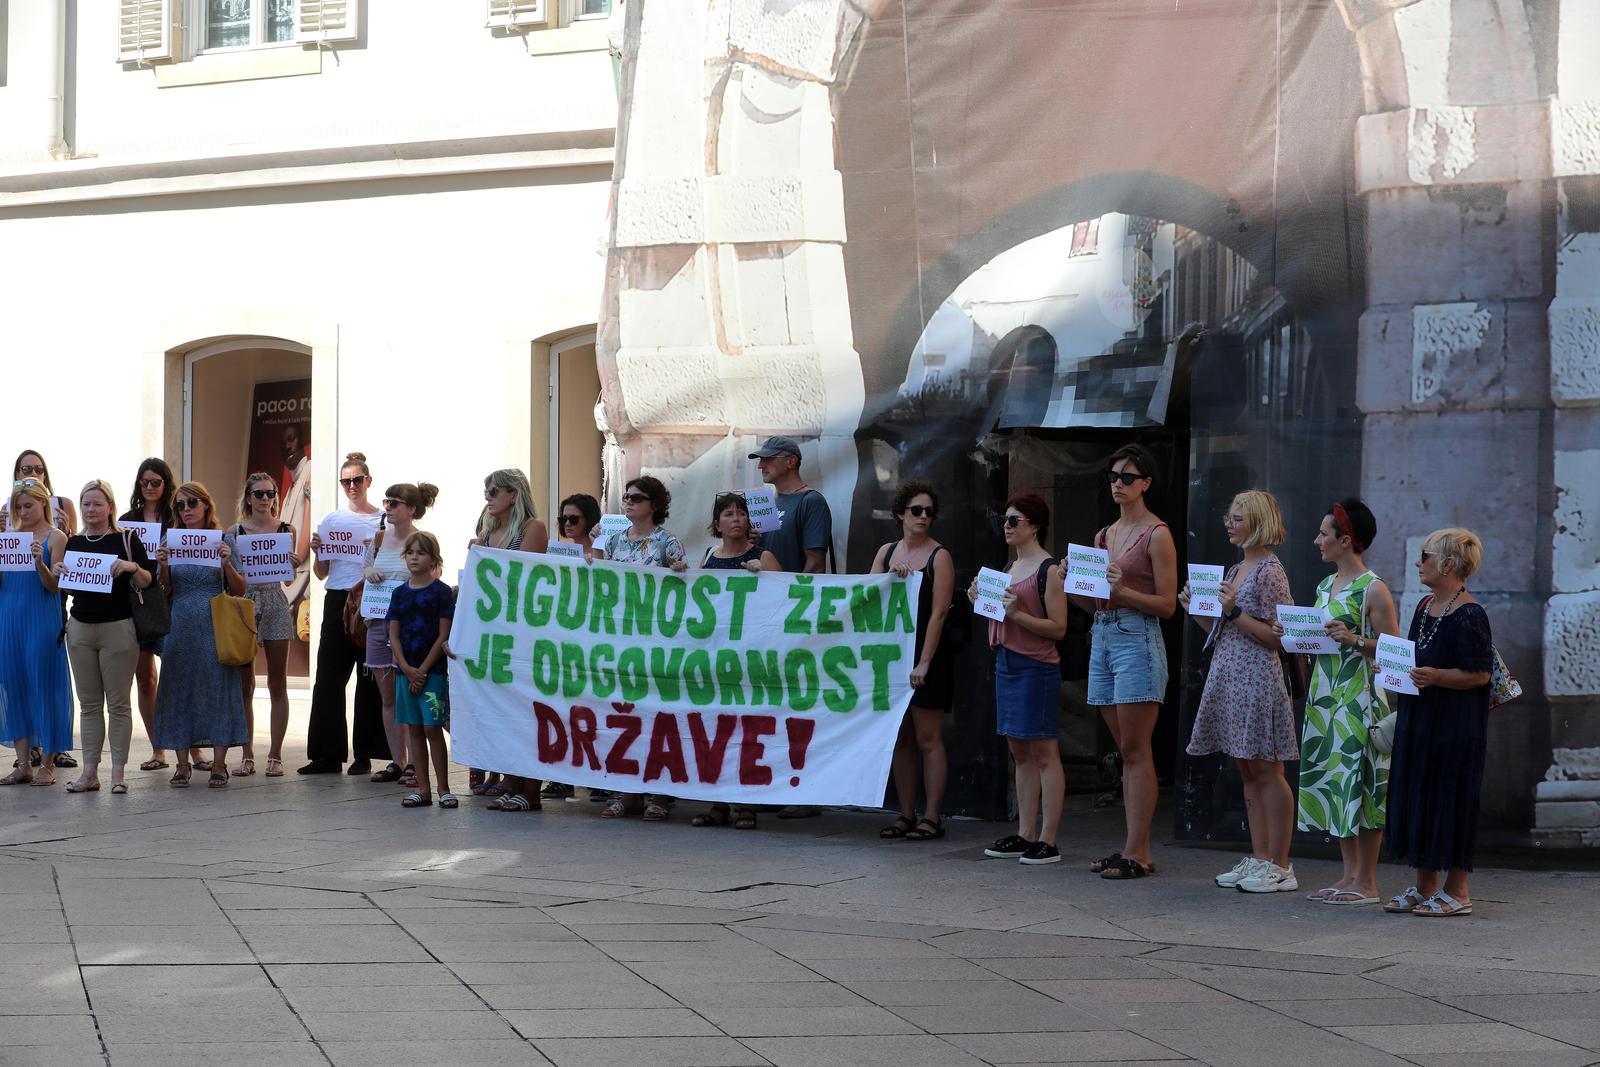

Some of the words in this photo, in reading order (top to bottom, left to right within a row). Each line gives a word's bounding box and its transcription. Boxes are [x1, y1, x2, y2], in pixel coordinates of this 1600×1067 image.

[257, 398, 297, 417] paco
[750, 507, 773, 518] ORNOST
[181, 535, 207, 546] STOP
[329, 531, 352, 542] STOP
[251, 540, 276, 551] STOP
[320, 544, 364, 557] FEMICIDU!
[0, 554, 32, 564] MICIDU!
[170, 548, 219, 561] FEMICIDU!
[241, 554, 289, 567] FEMICIDU!
[77, 557, 102, 569] STOP
[63, 571, 111, 586] FEMICIDU!
[1076, 566, 1106, 579] ODGOVORNOS
[476, 558, 758, 641] SIGURNOST
[783, 575, 915, 635] ŽENA
[1280, 613, 1307, 623] SIGURNOST
[1307, 613, 1321, 624] ŽENA
[1296, 641, 1321, 650] DRŽAVE!
[464, 632, 514, 684] JE
[532, 638, 902, 713] ODGOVORNOST
[532, 700, 816, 788] DRŽAVE!
